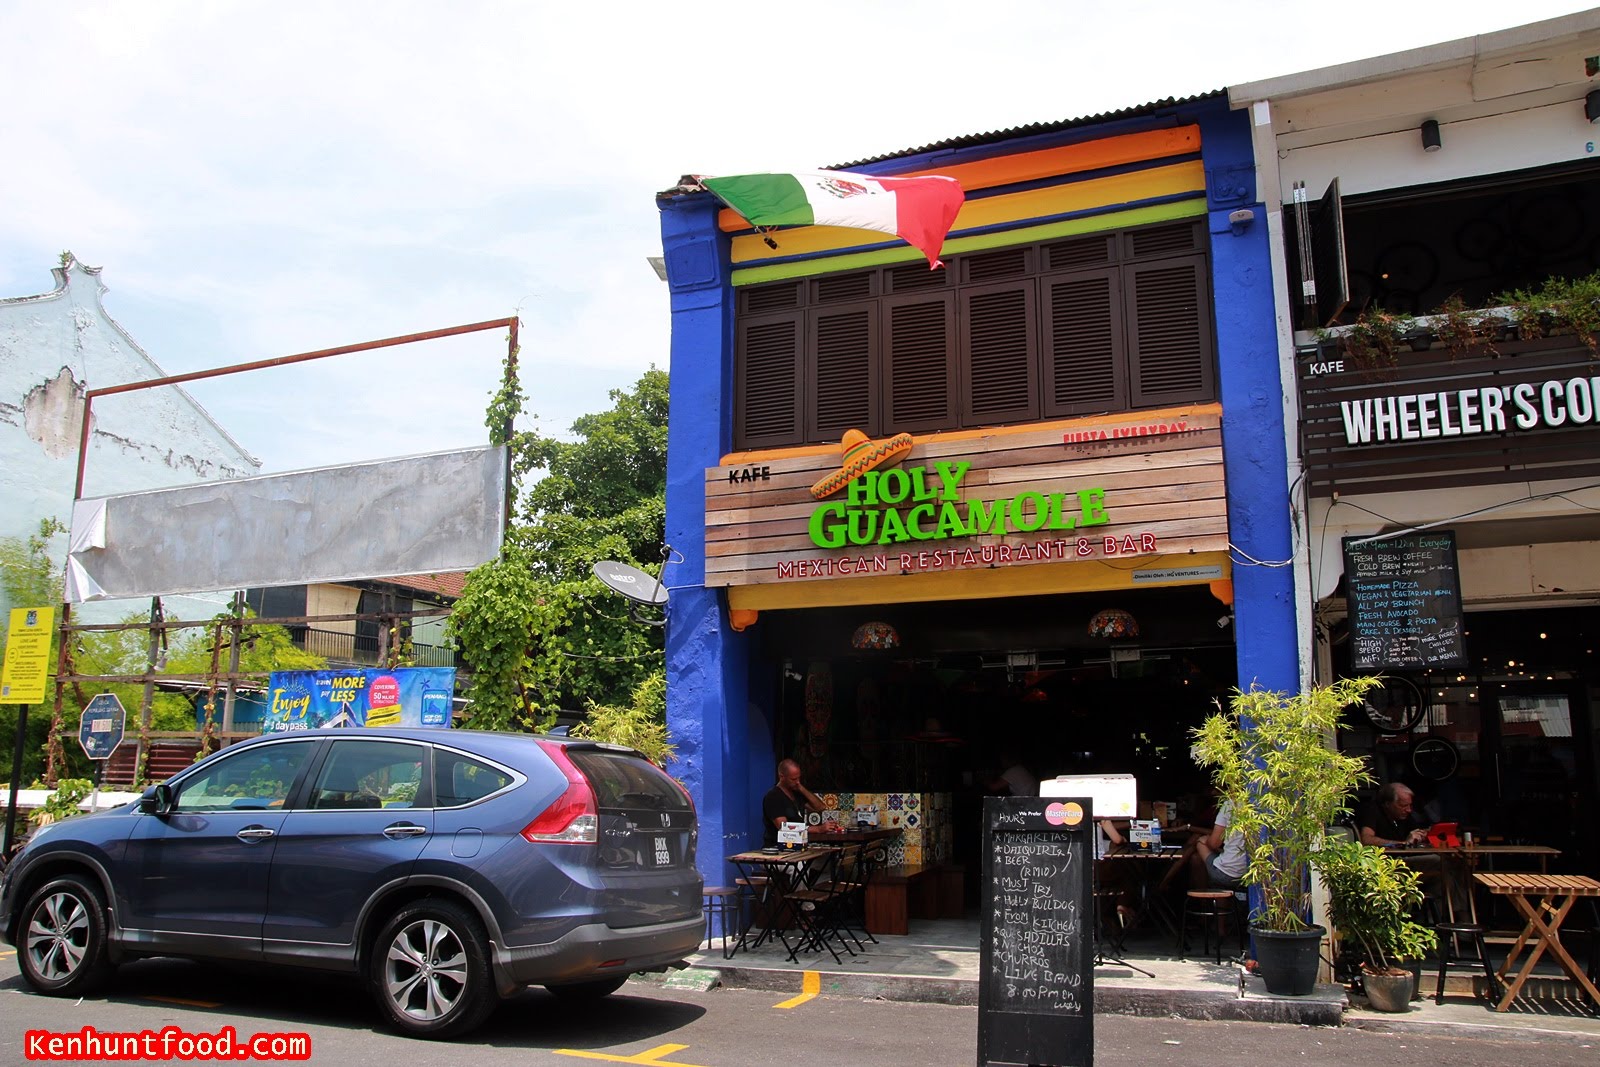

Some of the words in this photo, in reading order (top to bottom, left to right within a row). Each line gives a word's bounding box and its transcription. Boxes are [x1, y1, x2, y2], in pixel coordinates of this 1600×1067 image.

[1585, 141, 1594, 153] 6
[1309, 361, 1344, 375] KAFE
[1341, 384, 1538, 445] WHEELER'S
[1541, 376, 1600, 427] CO
[1063, 430, 1107, 444] FIESTA
[729, 466, 770, 484] KAFE
[847, 461, 971, 506] HOLY
[808, 488, 1109, 548] GUACAMOLE
[1419, 537, 1452, 551] Everyday
[777, 555, 888, 579] MEXICAN
[900, 540, 1066, 571] RESTAURANT
[1077, 538, 1092, 556] &
[1103, 533, 1158, 555] BAR
[1353, 555, 1373, 563] FRESH
[1378, 554, 1400, 562] BREW
[1402, 552, 1432, 560] COFFEE
[1357, 563, 1378, 571] COLD
[1392, 581, 1418, 589] PIZZA
[1358, 602, 1371, 610] ALL
[1392, 599, 1424, 607] BRUNCH
[1359, 612, 1382, 620] FRESH
[1387, 609, 1418, 618] AVOCADO
[332, 677, 365, 688] MORE
[330, 690, 356, 702] LESS
[272, 688, 310, 721] Enjoy
[999, 813, 1025, 825] HOURS
[655, 851, 670, 865] 1999
[1005, 856, 1031, 866] BEER
[1001, 951, 1050, 968] CHURROS
[1005, 966, 1037, 981] LIVE
[1044, 971, 1081, 987] BAND
